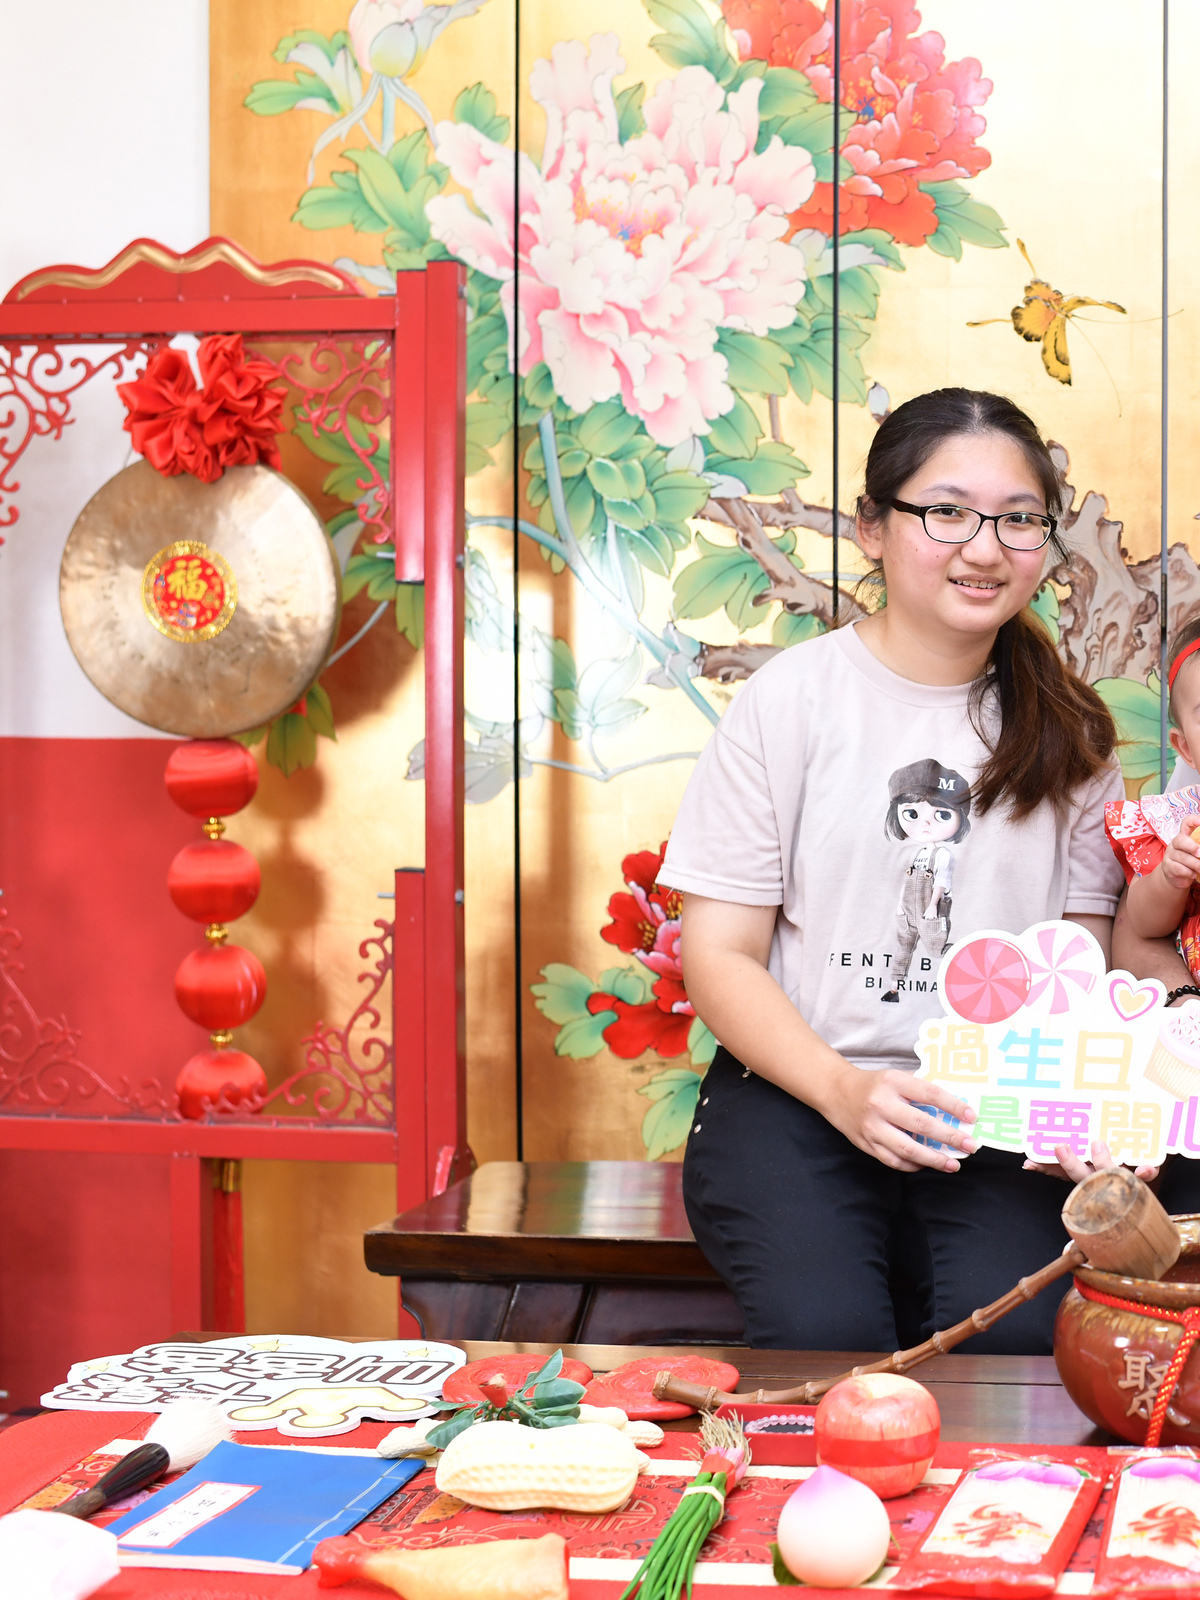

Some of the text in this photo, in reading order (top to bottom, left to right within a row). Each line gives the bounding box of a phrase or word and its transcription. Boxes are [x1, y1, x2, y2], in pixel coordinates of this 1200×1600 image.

[167, 559, 208, 601] 福
[938, 777, 956, 791] M
[923, 1023, 1134, 1091] 過生日
